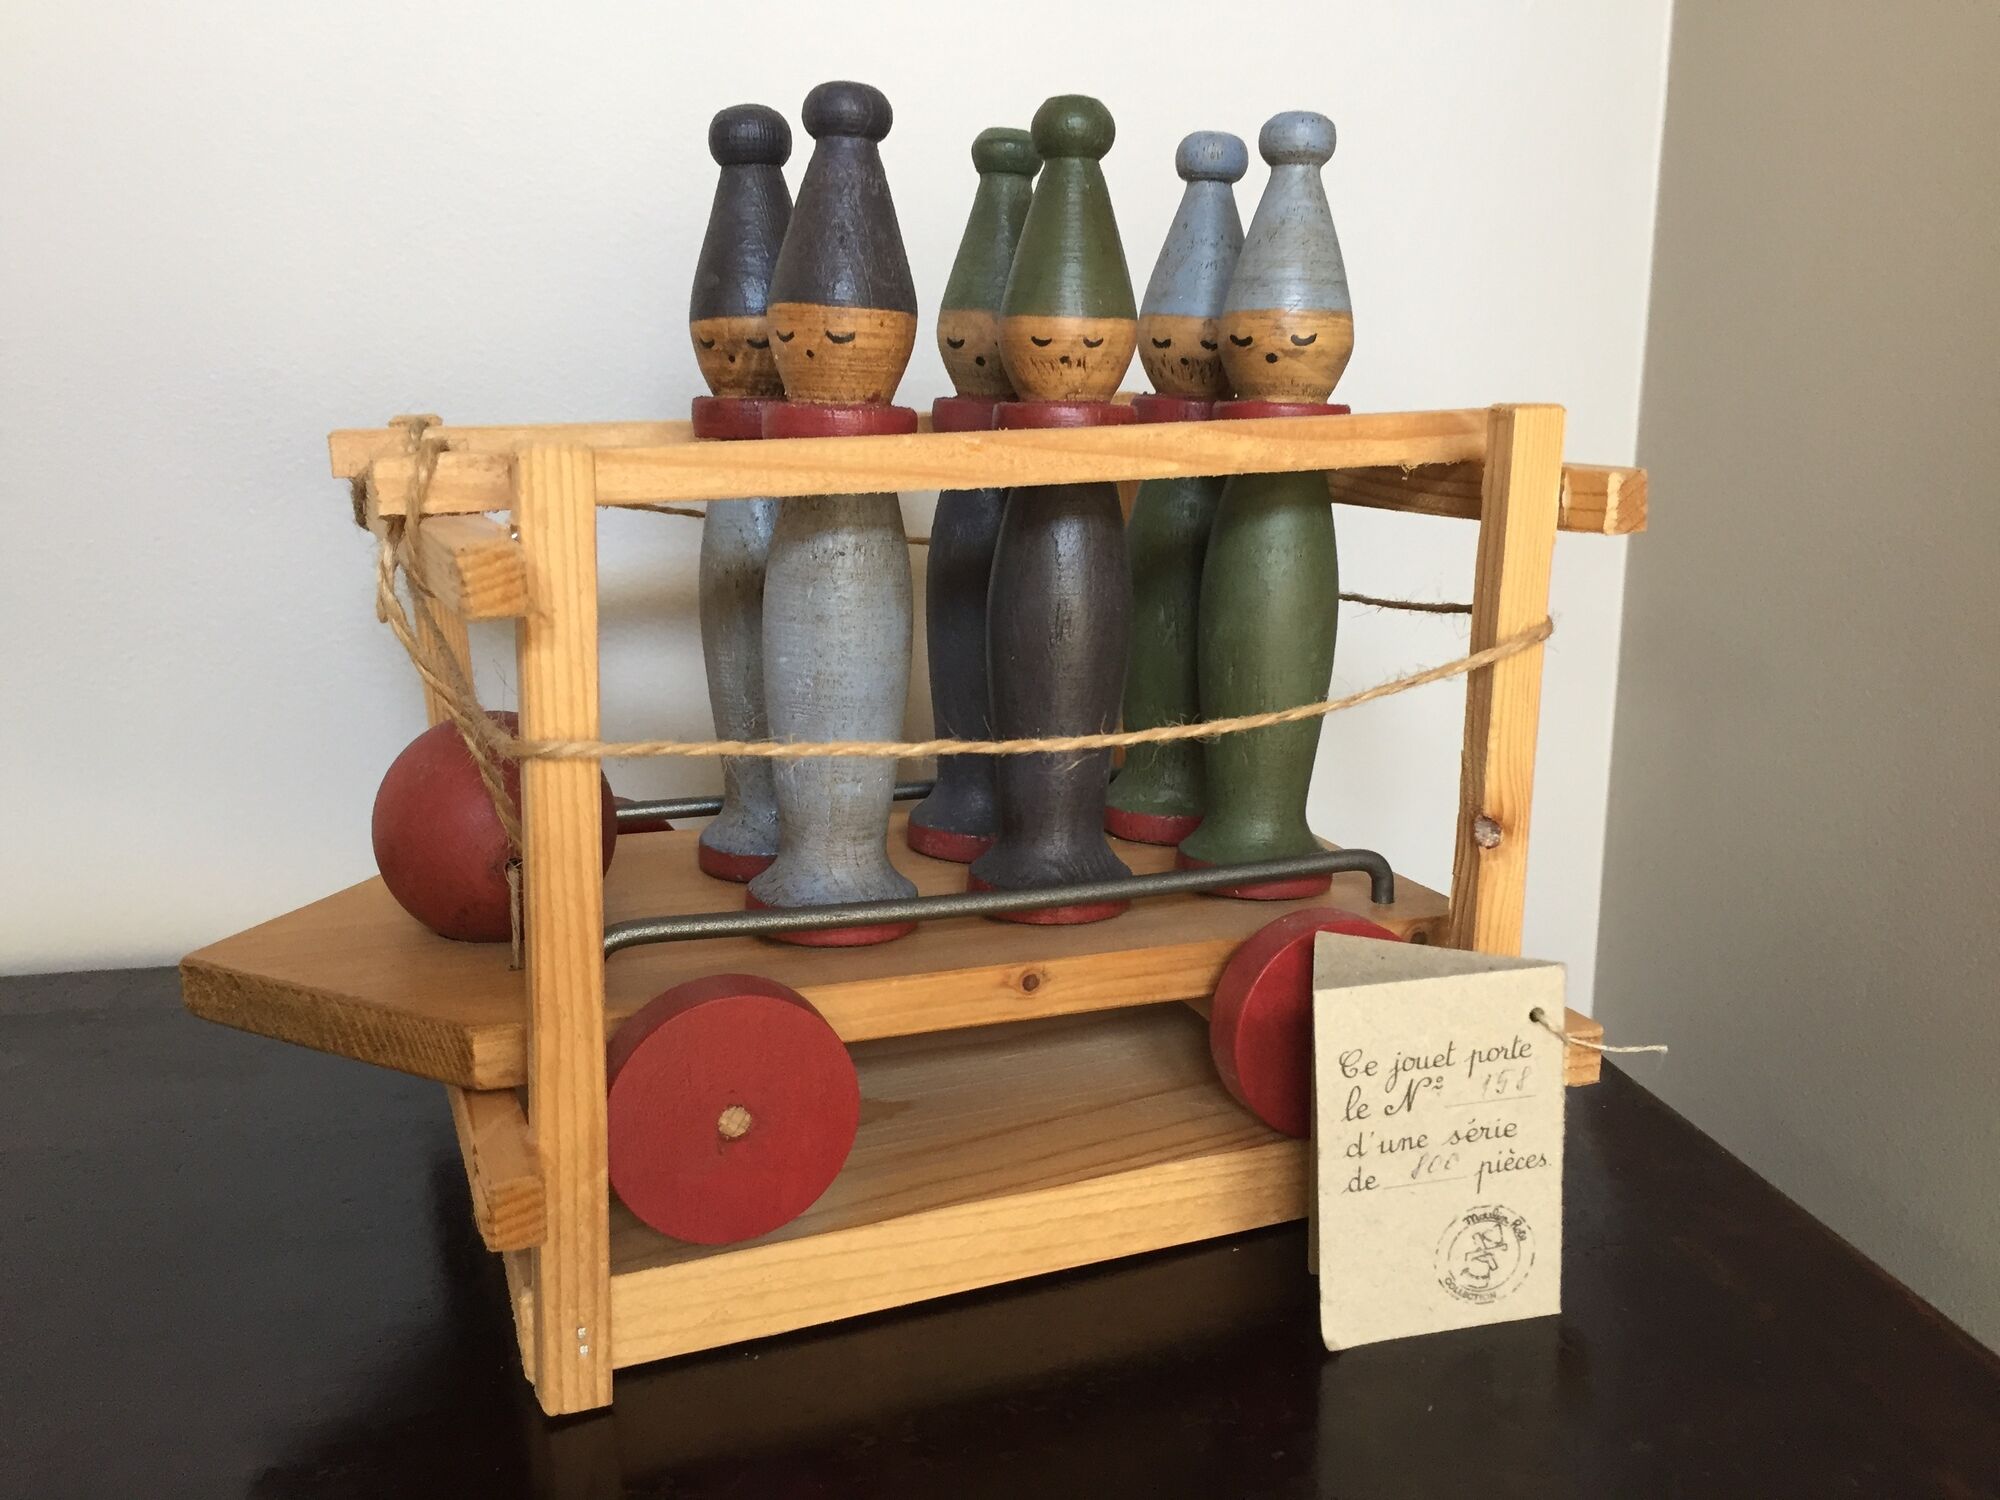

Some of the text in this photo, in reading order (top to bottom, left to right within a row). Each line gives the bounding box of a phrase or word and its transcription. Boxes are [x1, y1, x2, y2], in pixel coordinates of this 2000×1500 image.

[1339, 1035, 1532, 1093] Ce jouet porte
[1341, 1085, 1371, 1122] le
[1345, 1118, 1517, 1158] d'une série
[1342, 1166, 1380, 1194] de
[1444, 1277, 1497, 1301] COLLECTION
